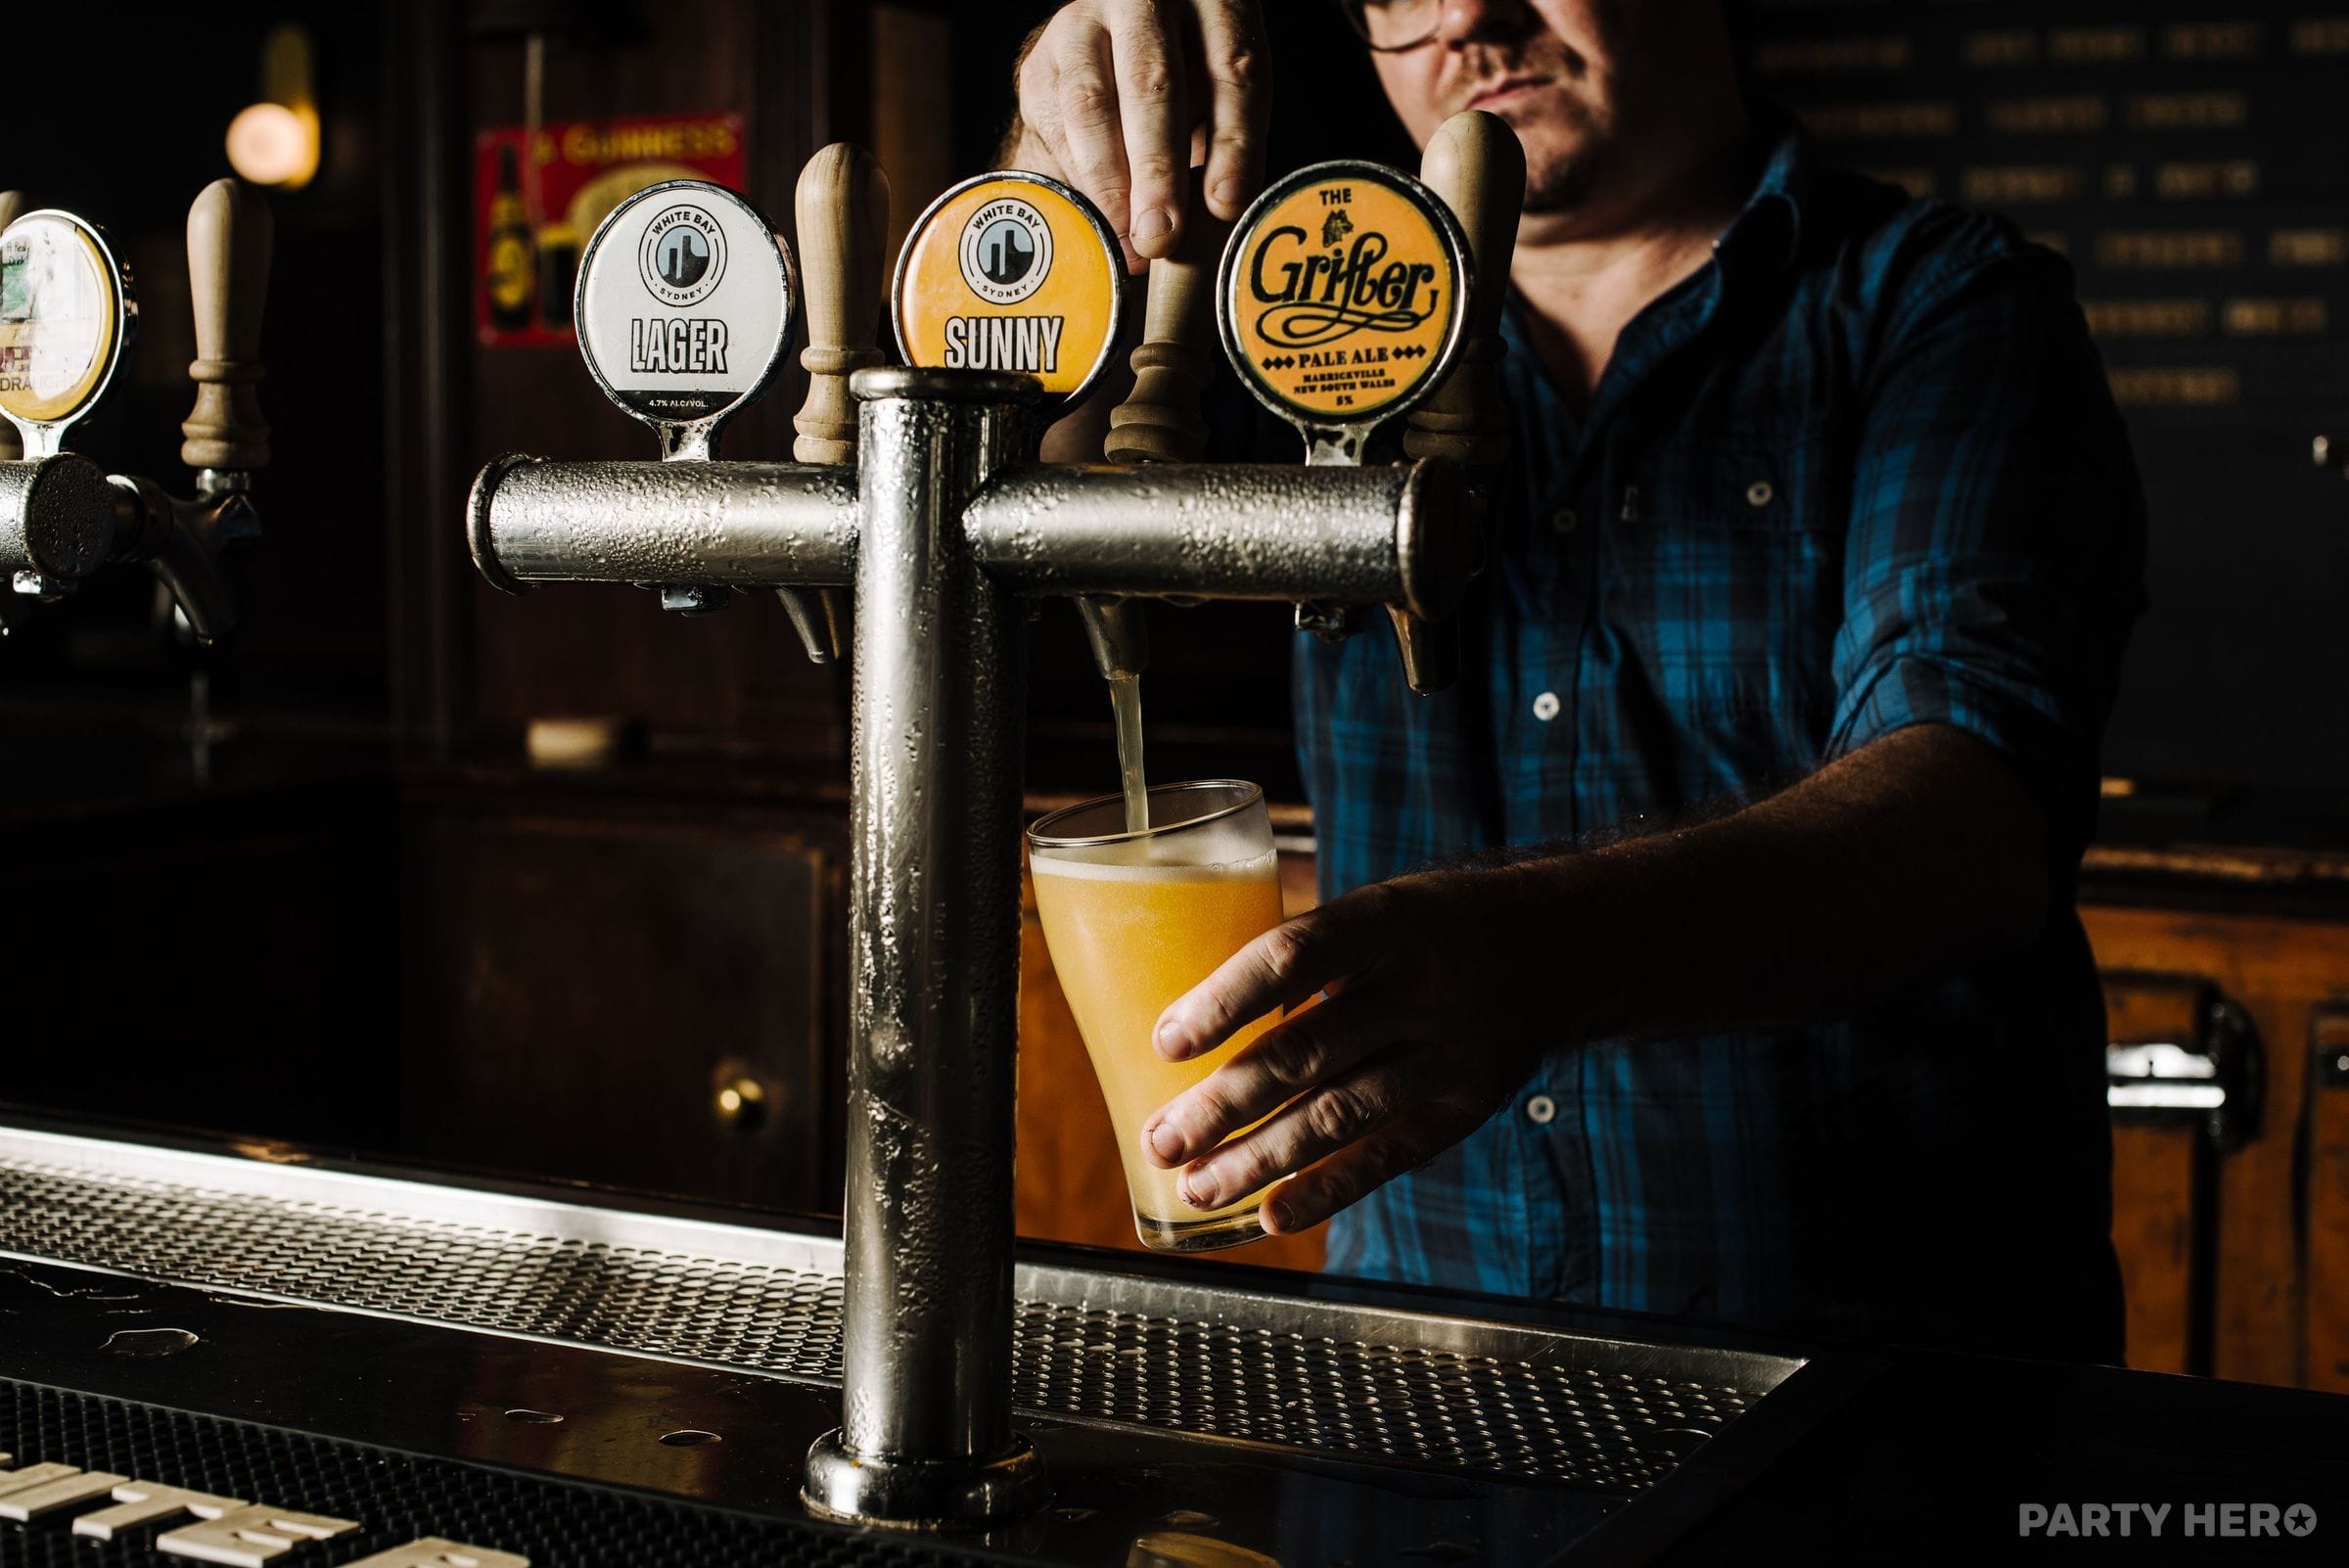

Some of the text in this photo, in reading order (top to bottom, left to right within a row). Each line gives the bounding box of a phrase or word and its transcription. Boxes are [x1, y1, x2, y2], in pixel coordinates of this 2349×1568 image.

[1319, 188, 1352, 206] THE
[652, 210, 716, 236] WHITE BAY
[973, 205, 1040, 231] WHITE BAY
[660, 287, 704, 300] SYDNEY
[983, 284, 1029, 298] SYDNEY
[1250, 225, 1440, 348] Grifter
[630, 318, 728, 374] LAGER
[944, 316, 1065, 373] SUNNY
[1299, 347, 1389, 369] PALE ALE
[1303, 369, 1385, 383] MARRICKVILLE
[1294, 379, 1396, 394] NEW SOUTH WALES
[669, 399, 709, 408] ALC/VOL.
[1336, 395, 1354, 406] 5%
